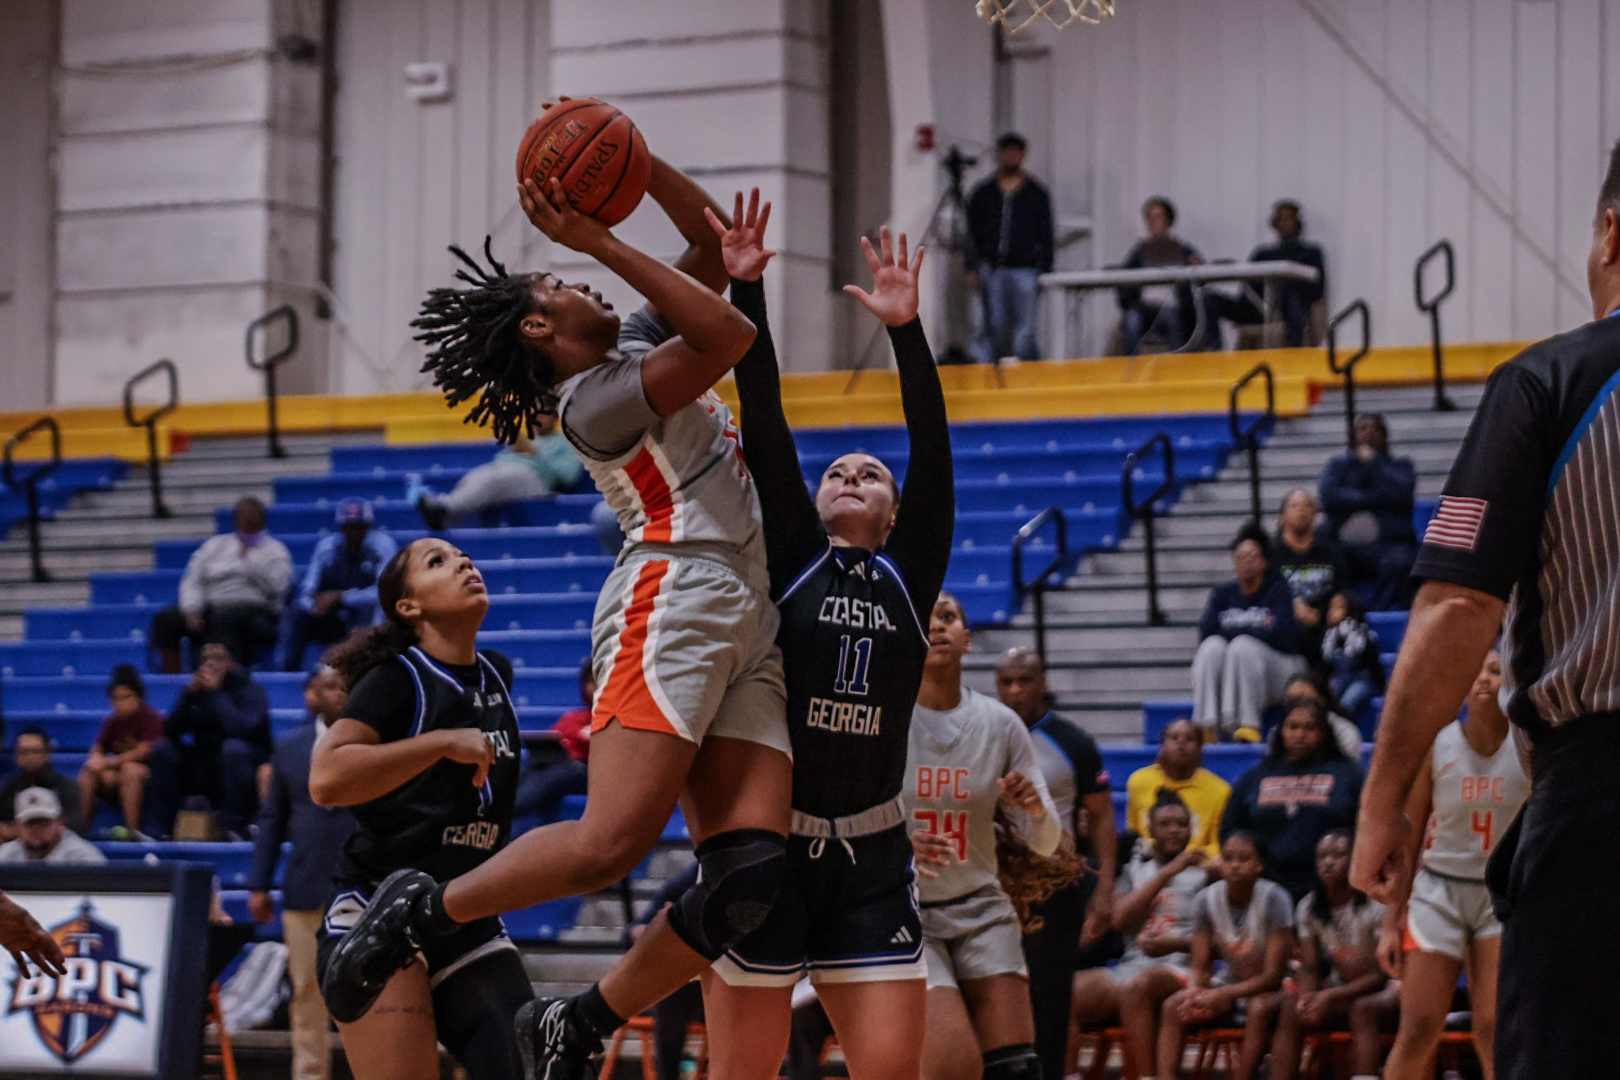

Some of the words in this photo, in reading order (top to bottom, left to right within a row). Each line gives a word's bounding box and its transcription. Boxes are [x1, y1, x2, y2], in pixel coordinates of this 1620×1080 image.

[567, 136, 618, 206] SPALDIN
[833, 634, 873, 695] 11
[807, 697, 882, 735] GEORGIA
[917, 766, 969, 800] BPC
[1461, 776, 1505, 802] BPC
[1471, 810, 1493, 852] 4
